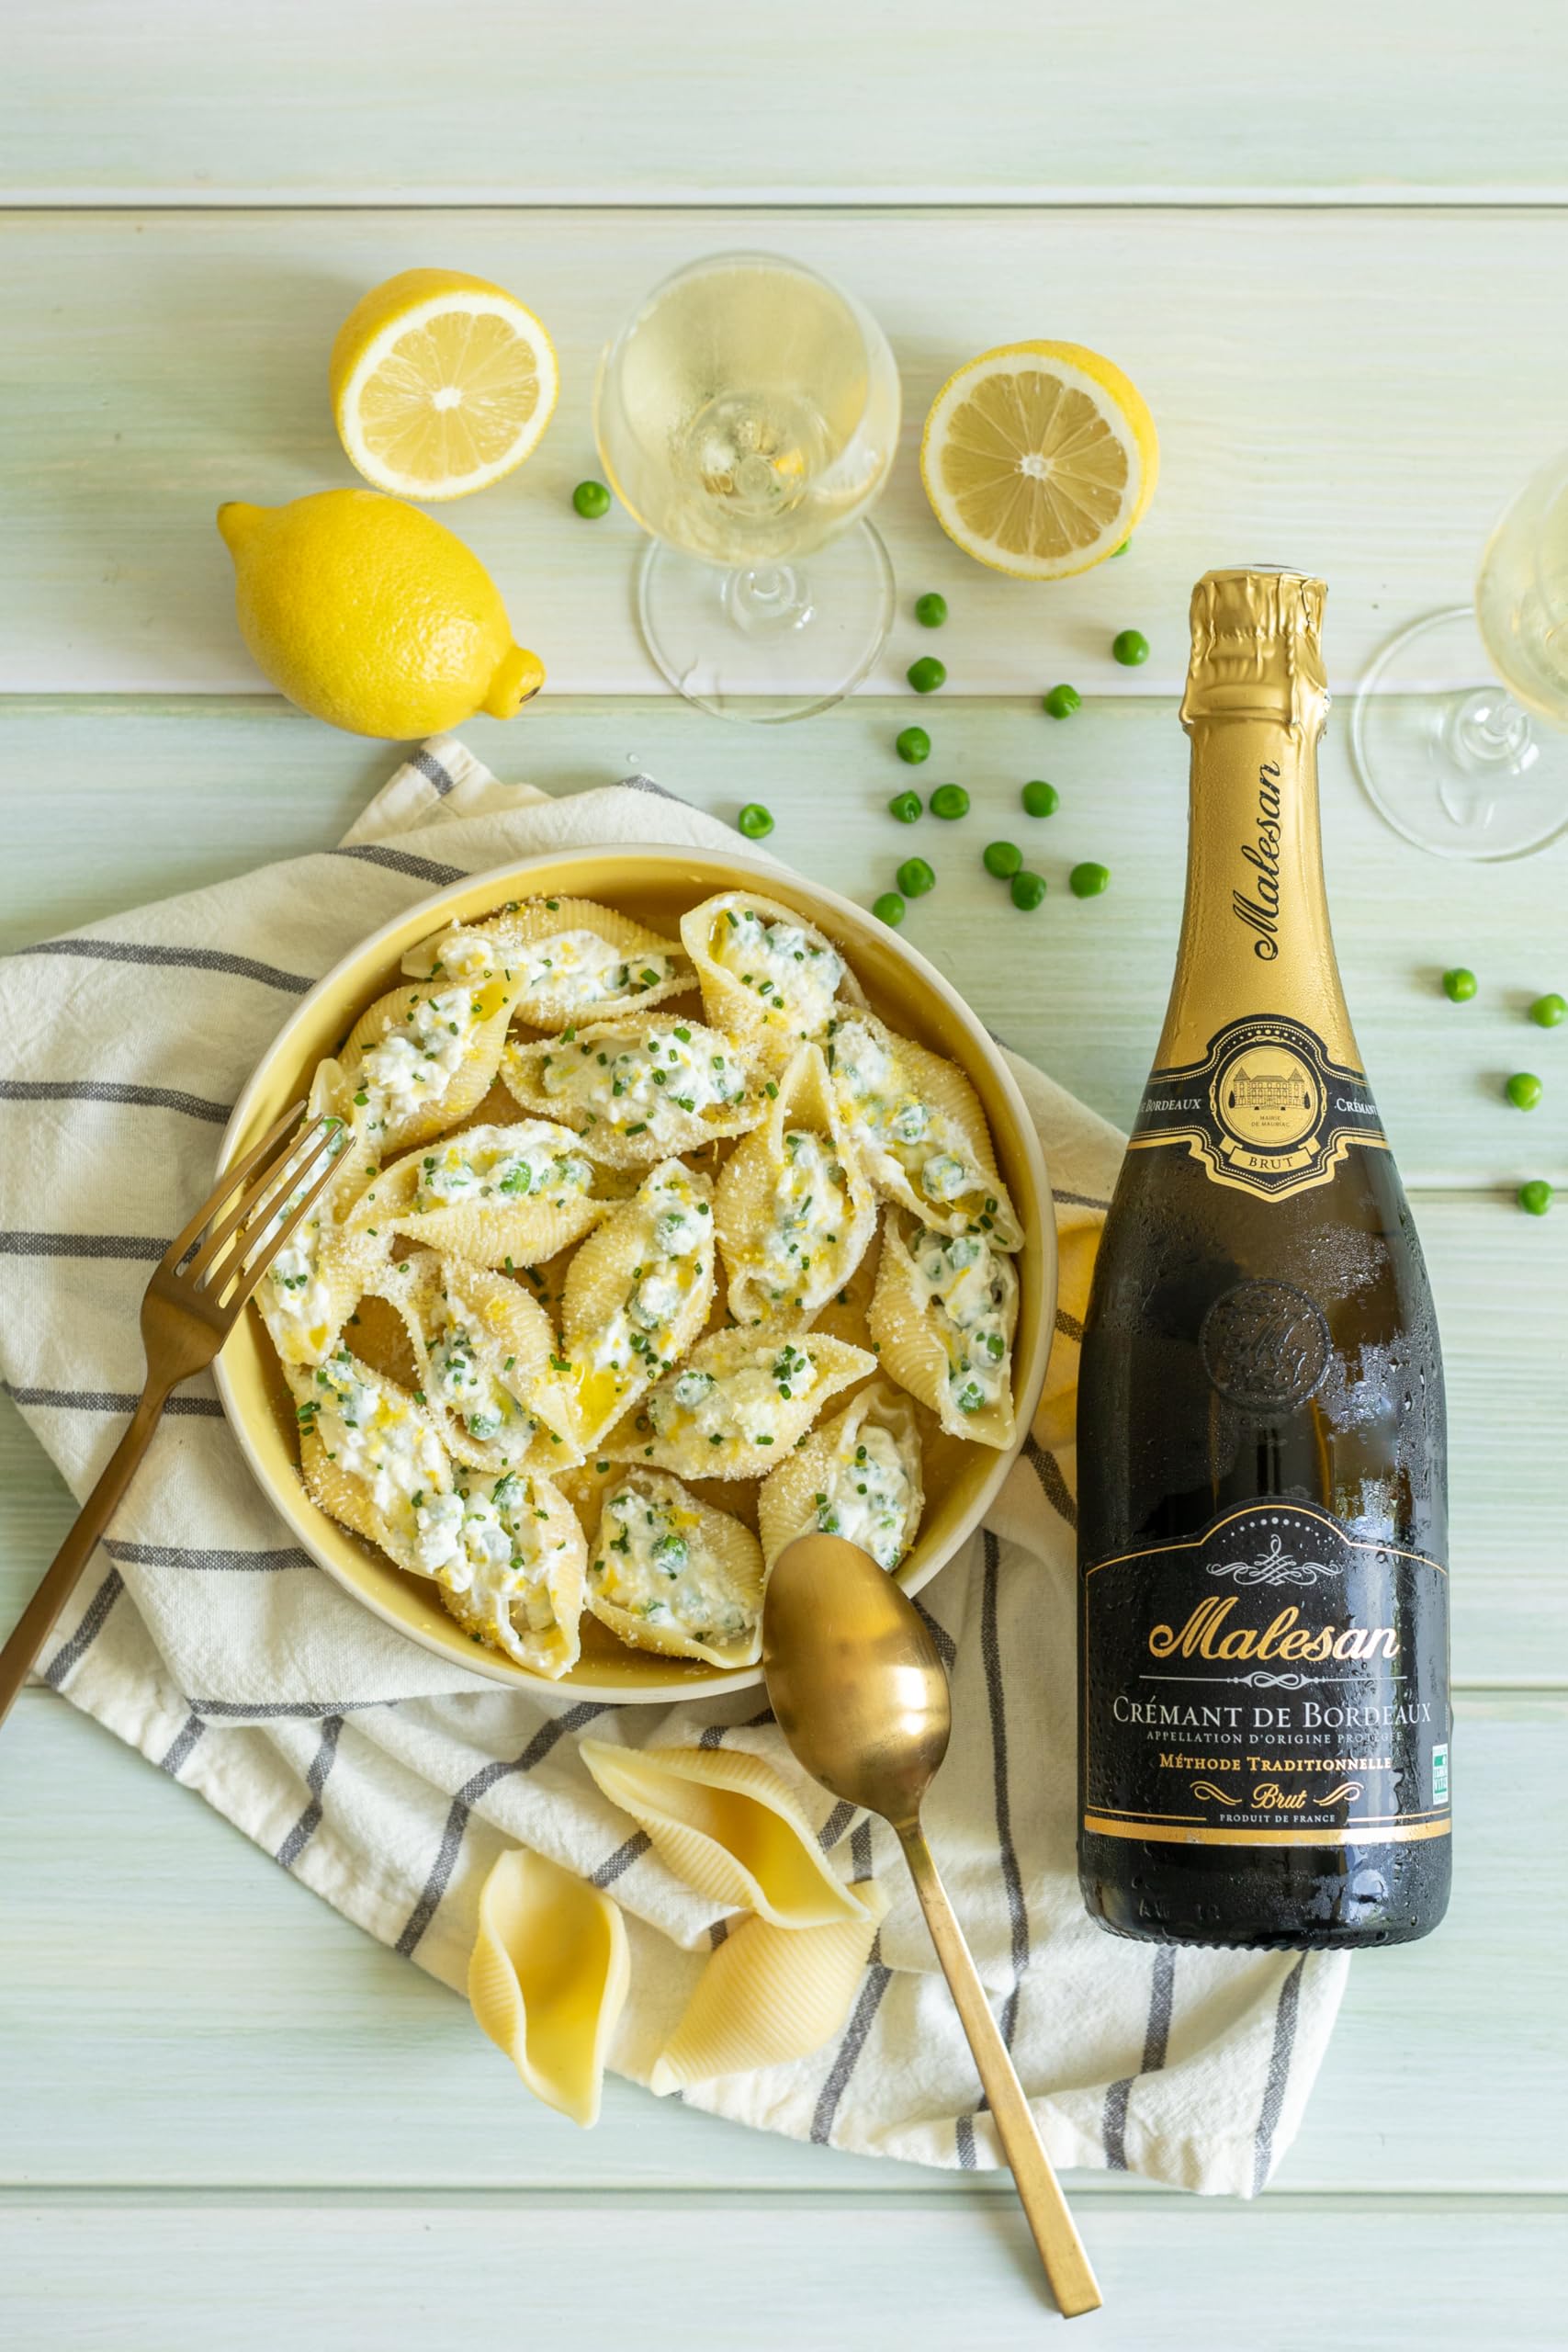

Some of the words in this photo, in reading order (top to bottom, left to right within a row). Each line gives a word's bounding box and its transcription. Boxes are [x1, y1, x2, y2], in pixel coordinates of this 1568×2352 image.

[1233, 761, 1281, 962] Malesan
[1145, 1099, 1202, 1112] BORDEAUX
[1248, 1156, 1293, 1170] BRUT
[1148, 1596, 1401, 1662] Malesan
[1112, 1695, 1243, 1728] CRÉMANT
[1253, 1707, 1292, 1728] DE
[1303, 1702, 1432, 1728] BORDEAUX
[1146, 1731, 1243, 1744] APPELLATION
[1249, 1734, 1331, 1745] D'ORIGINE
[1159, 1753, 1241, 1771] MÉTHODE
[1247, 1756, 1392, 1772] TRADITIONNELLE
[1251, 1782, 1308, 1809] Brut
[1219, 1814, 1270, 1823] PRODUIT
[1275, 1815, 1289, 1824] DE
[1293, 1814, 1336, 1824] FRANCE
